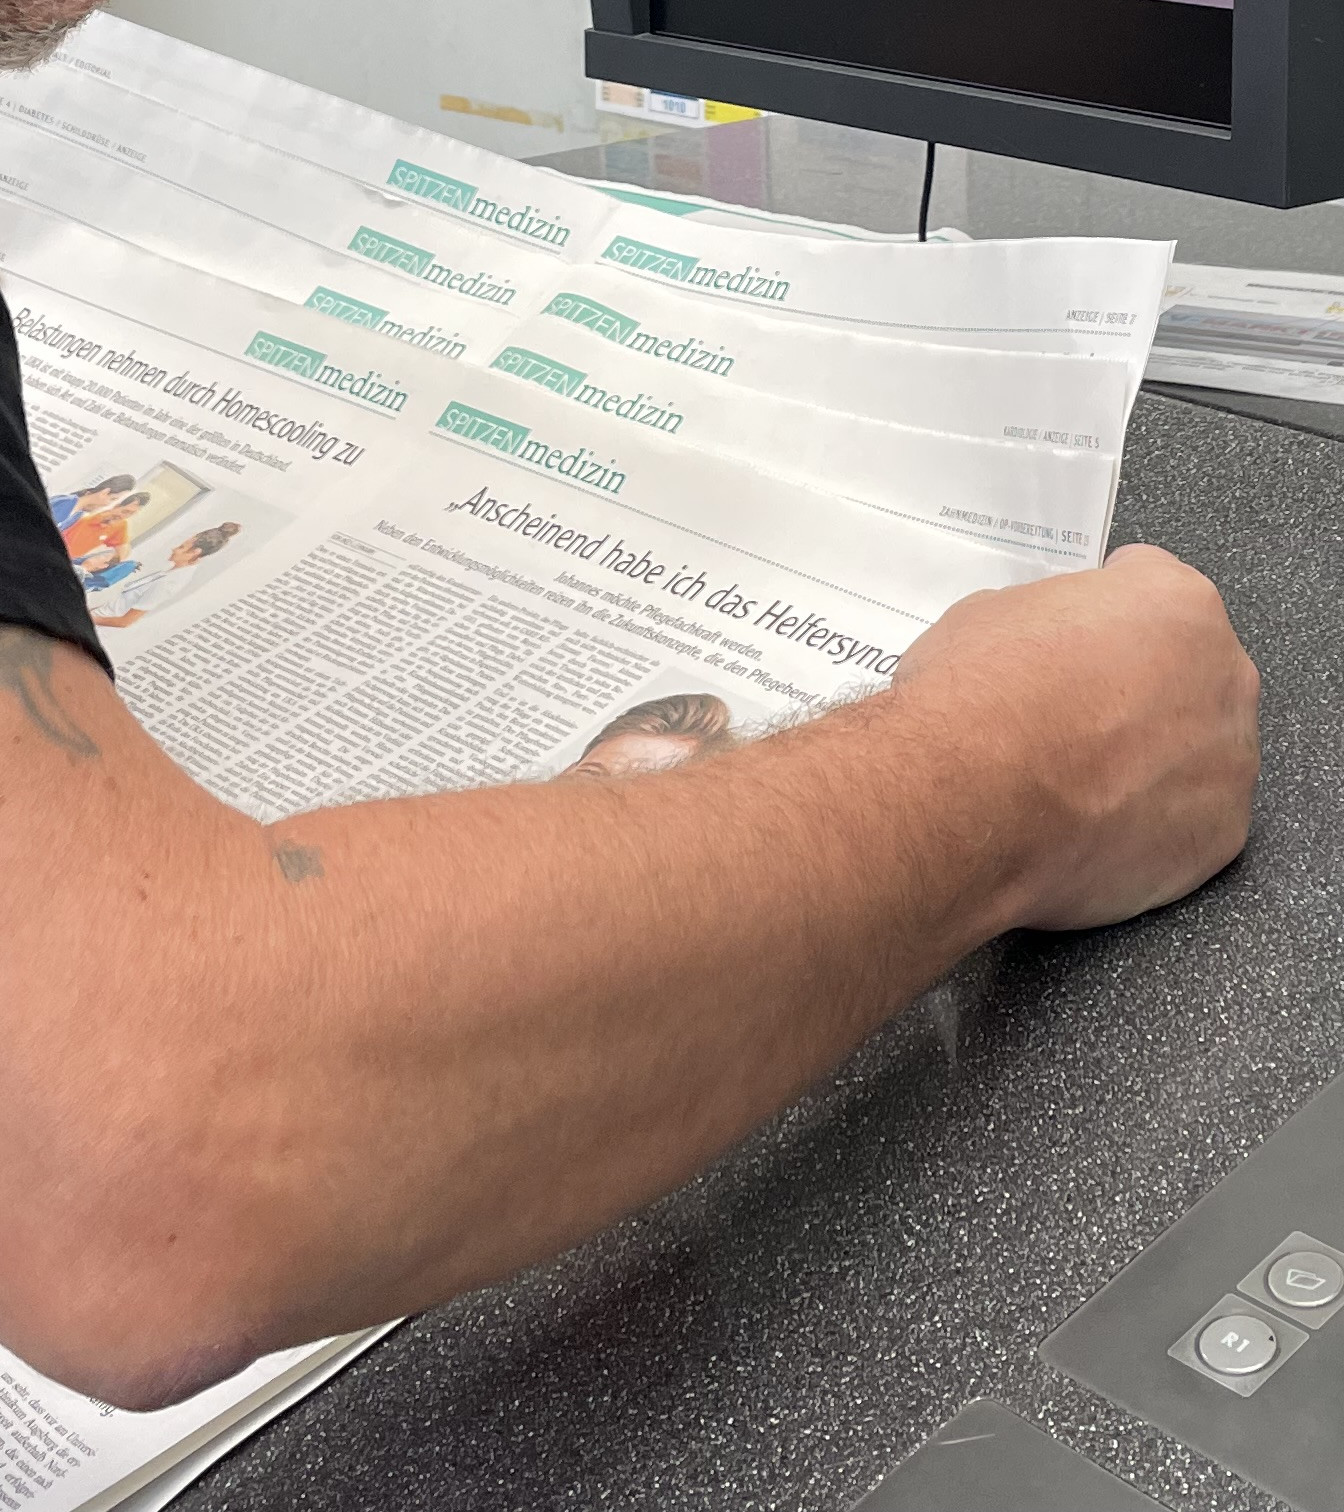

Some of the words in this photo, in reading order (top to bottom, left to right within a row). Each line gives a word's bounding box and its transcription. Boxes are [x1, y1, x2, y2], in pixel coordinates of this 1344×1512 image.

[12, 306, 103, 361] Belastungen
[98, 349, 169, 389] nehmen
[163, 370, 218, 409] durch
[211, 388, 333, 460] Homescooling
[332, 441, 367, 466] zu
[553, 570, 601, 597] Johannes
[599, 539, 665, 584] habe
[661, 564, 707, 602] ich
[704, 582, 759, 621] das
[1220, 1331, 1250, 1353] R1
